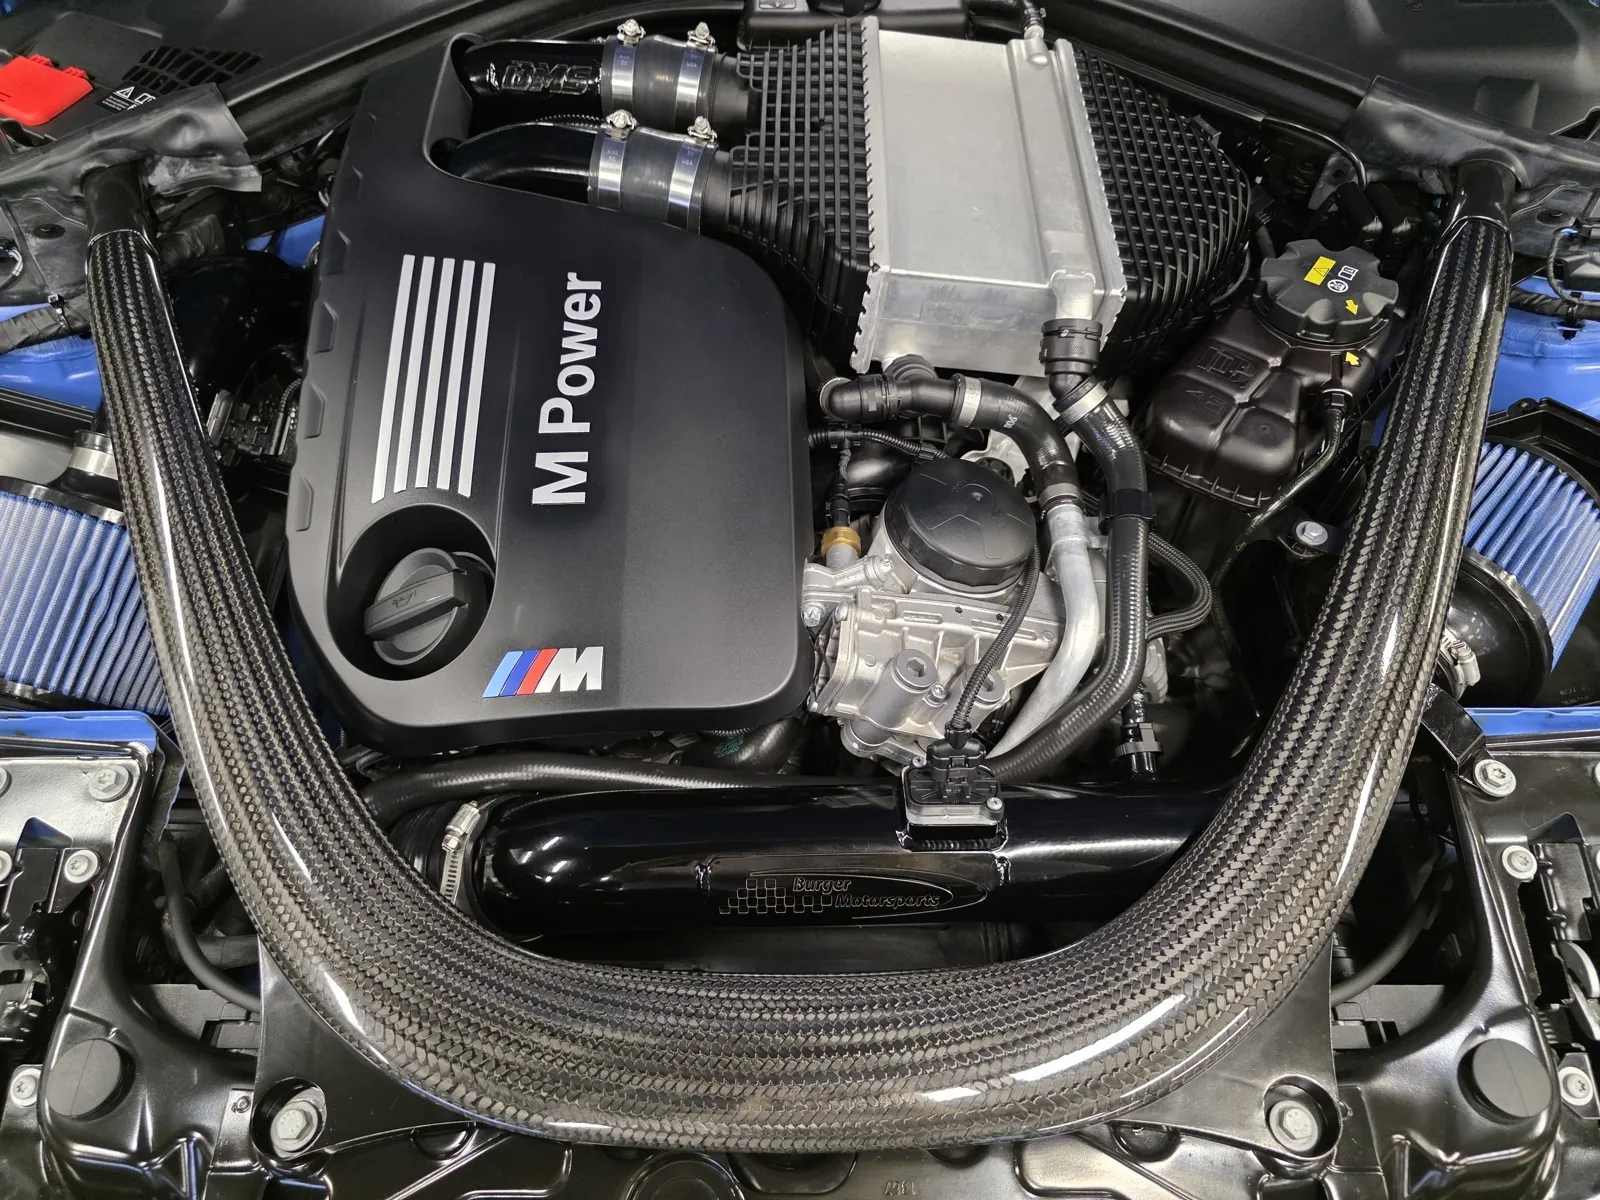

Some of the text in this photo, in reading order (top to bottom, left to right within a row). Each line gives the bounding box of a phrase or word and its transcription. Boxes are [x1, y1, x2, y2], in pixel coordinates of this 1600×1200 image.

[531, 272, 602, 505] M Power
[792, 876, 852, 895] Burger
[834, 893, 941, 910] Motorsports
